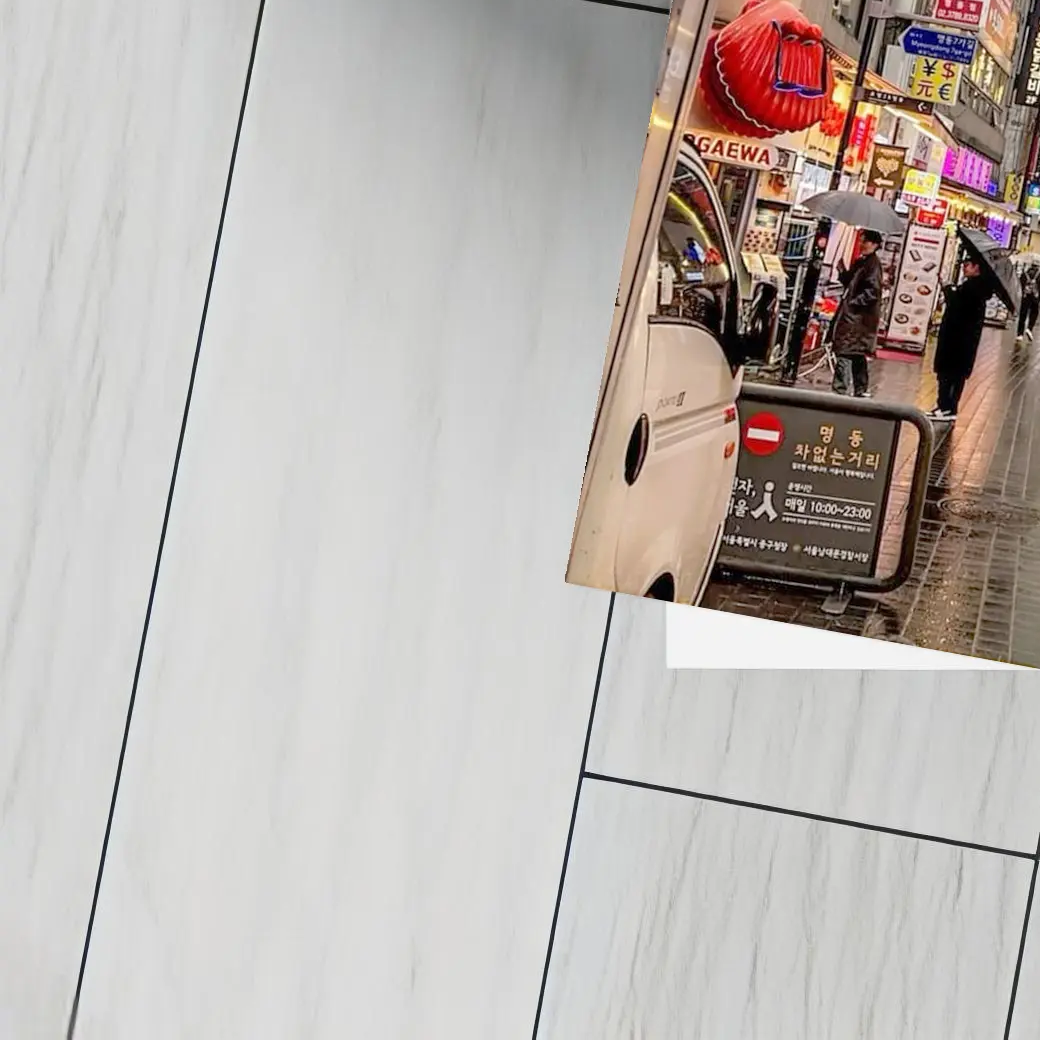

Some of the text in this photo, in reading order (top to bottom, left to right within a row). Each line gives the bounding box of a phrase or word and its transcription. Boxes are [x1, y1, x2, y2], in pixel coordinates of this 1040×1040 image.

[819, 425, 864, 448] 명동
[794, 443, 880, 471] 차없는거리
[784, 497, 872, 520] 매일 10:00~23:00
